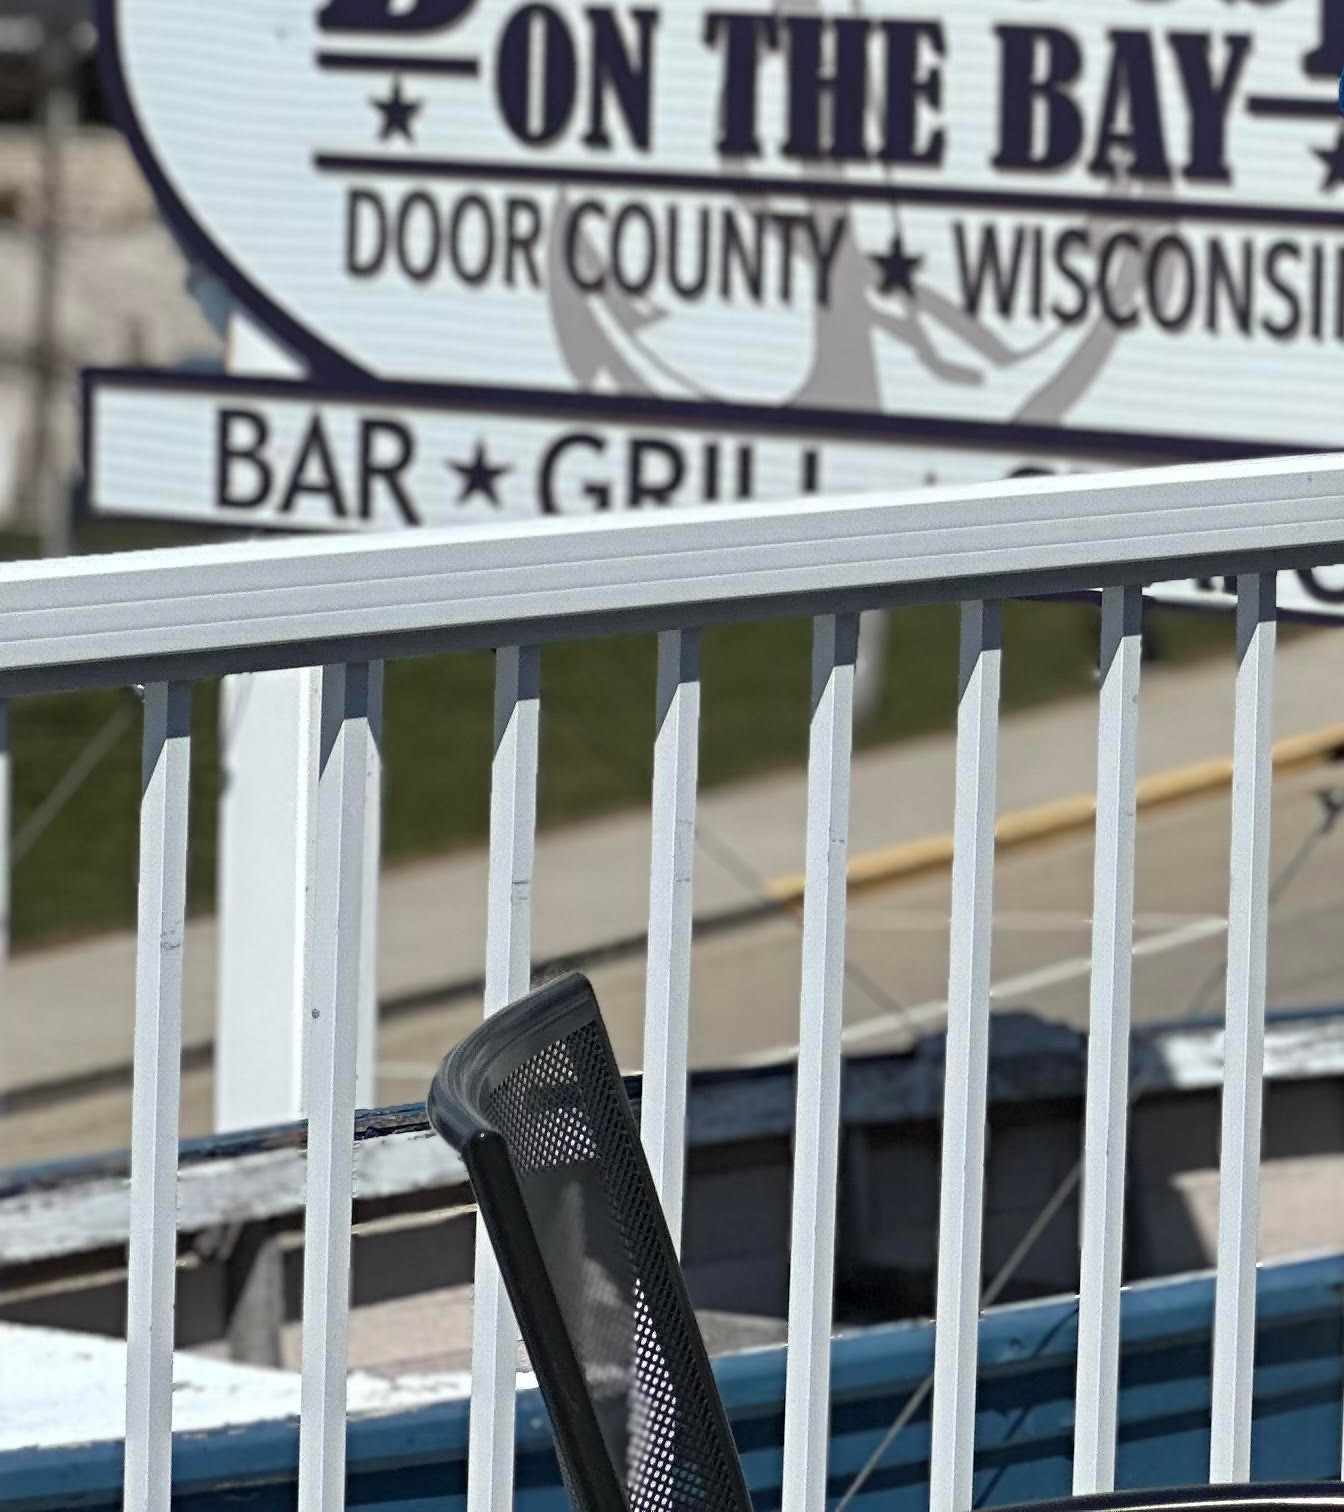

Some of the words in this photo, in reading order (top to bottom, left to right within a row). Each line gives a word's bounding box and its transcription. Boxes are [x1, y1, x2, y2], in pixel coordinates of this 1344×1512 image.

[494, 0, 660, 152] ON
[702, 11, 947, 170] THE
[989, 23, 1254, 186] BAY
[344, 188, 545, 288] DOOR
[563, 195, 854, 312] COUNTY
[212, 407, 423, 527] BAR
